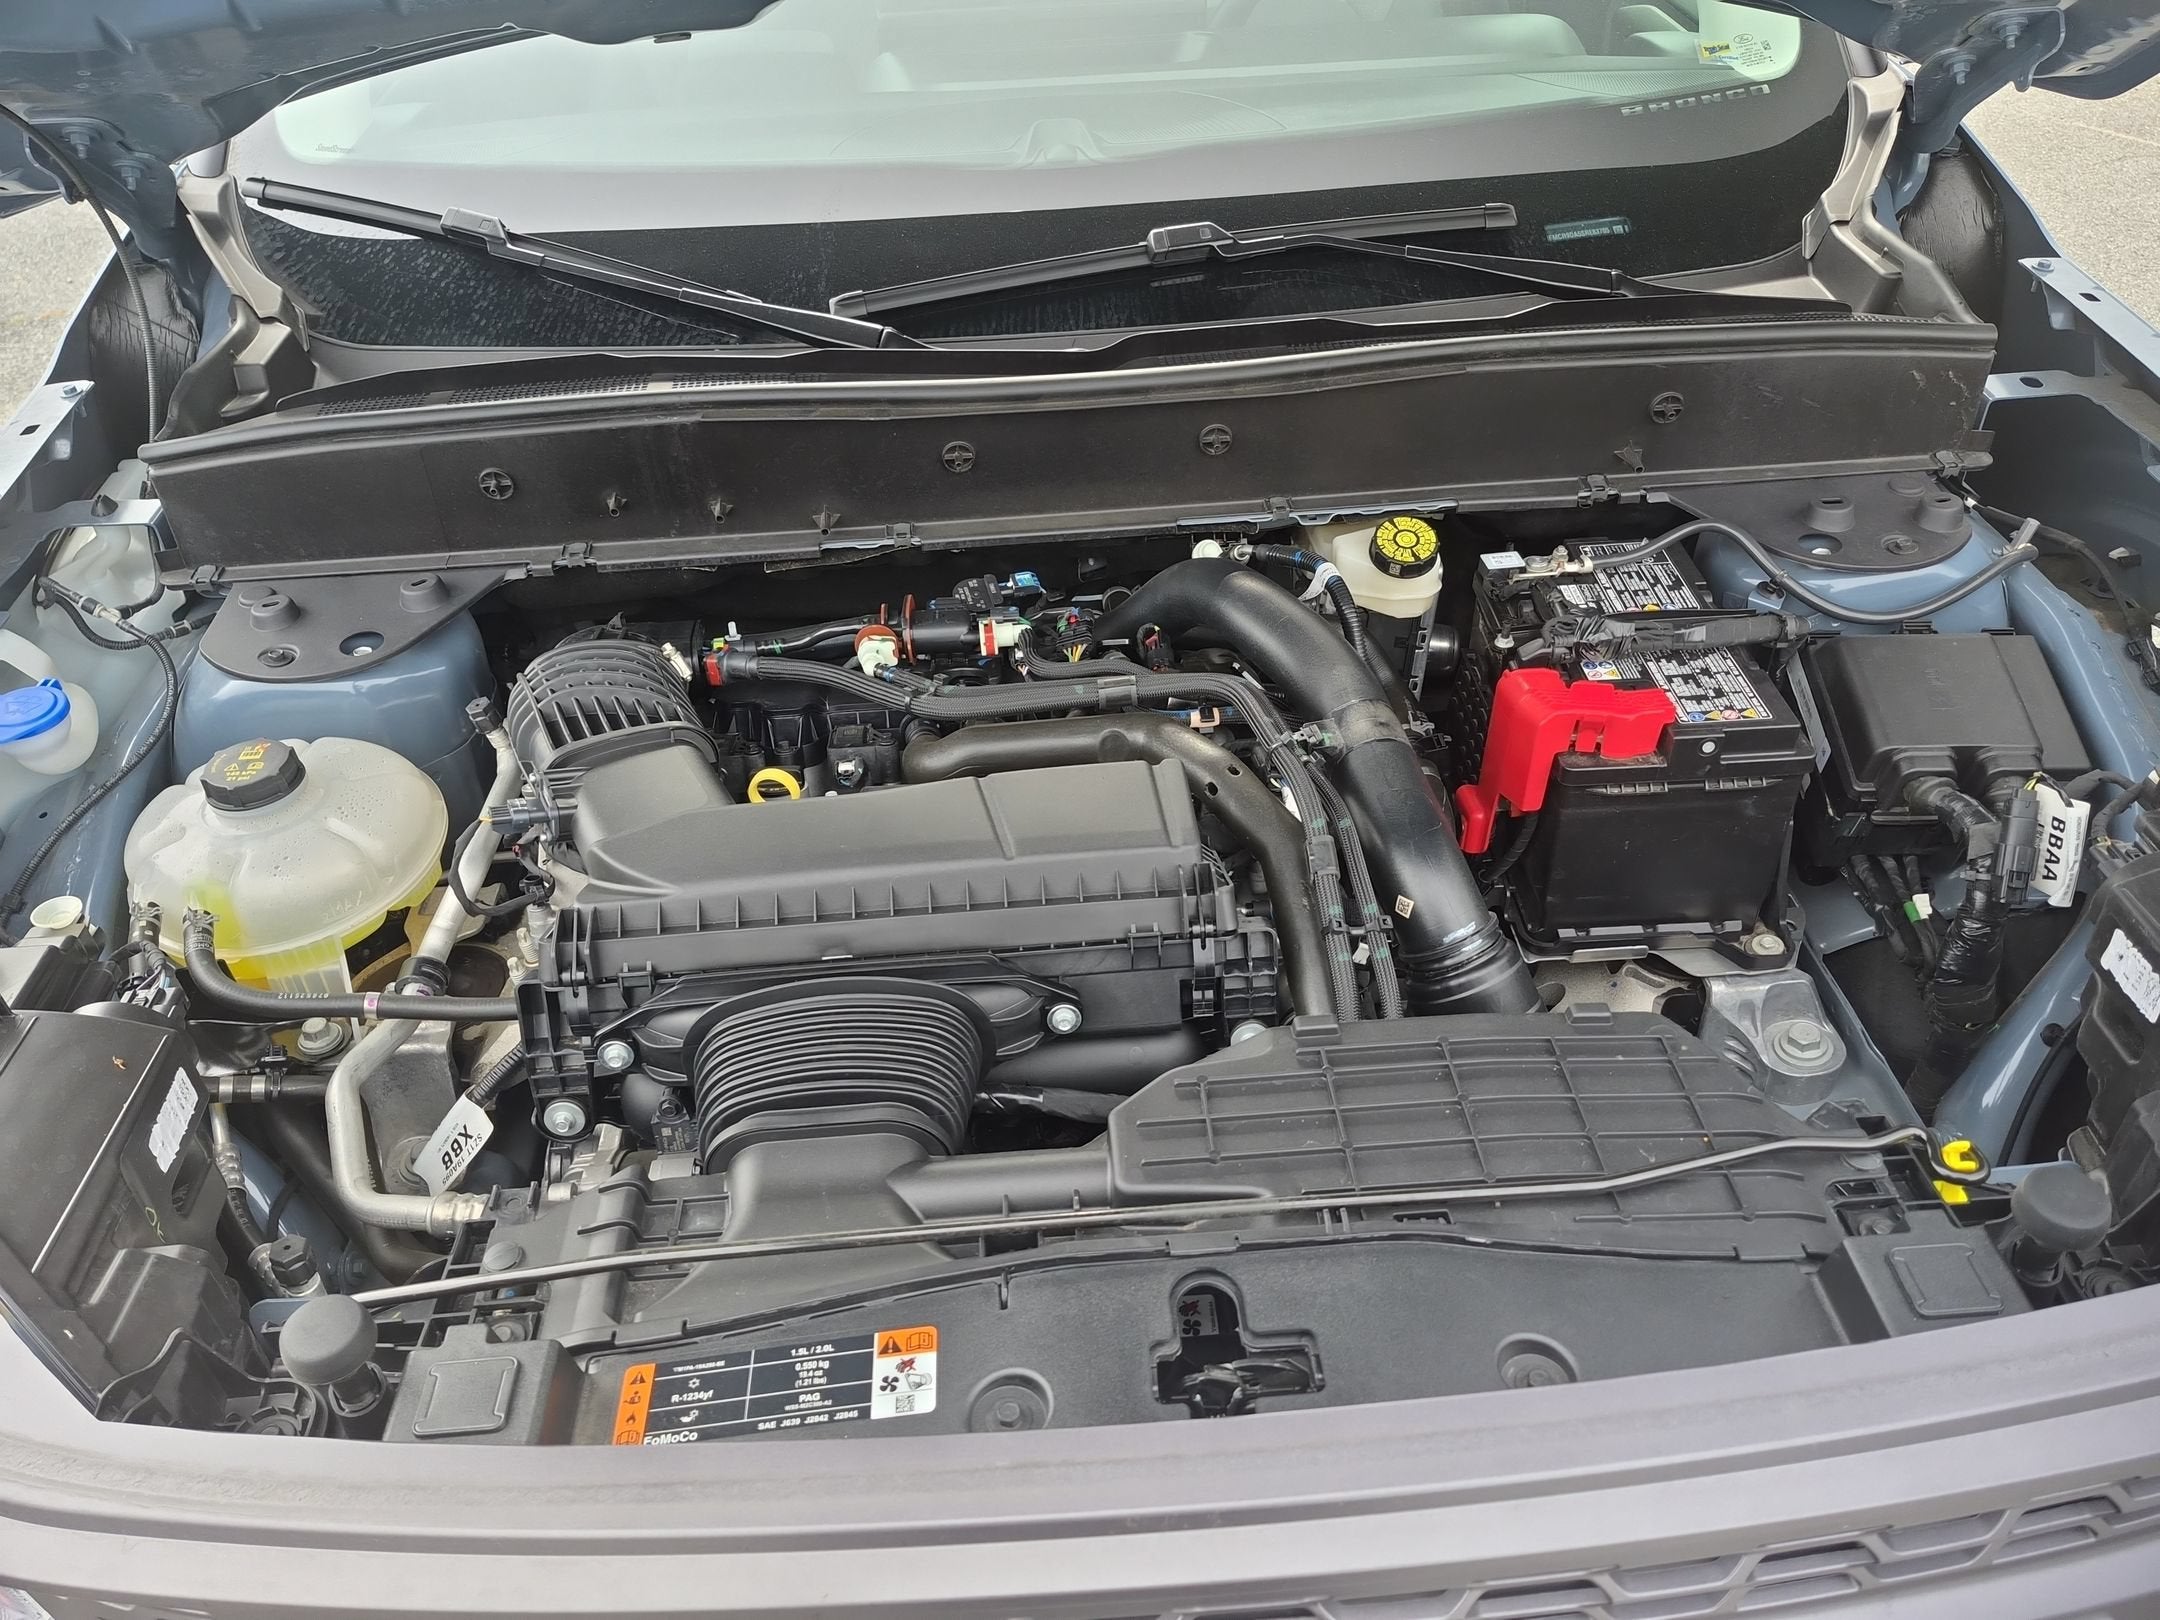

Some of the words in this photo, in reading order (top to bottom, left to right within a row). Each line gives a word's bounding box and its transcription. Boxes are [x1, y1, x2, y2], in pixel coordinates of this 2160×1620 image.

[2042, 815, 2066, 881] BBAA
[441, 1124, 474, 1171] XBB
[815, 1343, 835, 1353] 2.0L
[818, 1359, 830, 1369] kg
[670, 1389, 714, 1404] R-1234yf
[798, 1392, 821, 1403] PAG
[757, 1420, 777, 1430] SAE
[642, 1430, 698, 1447] FoMoCo
